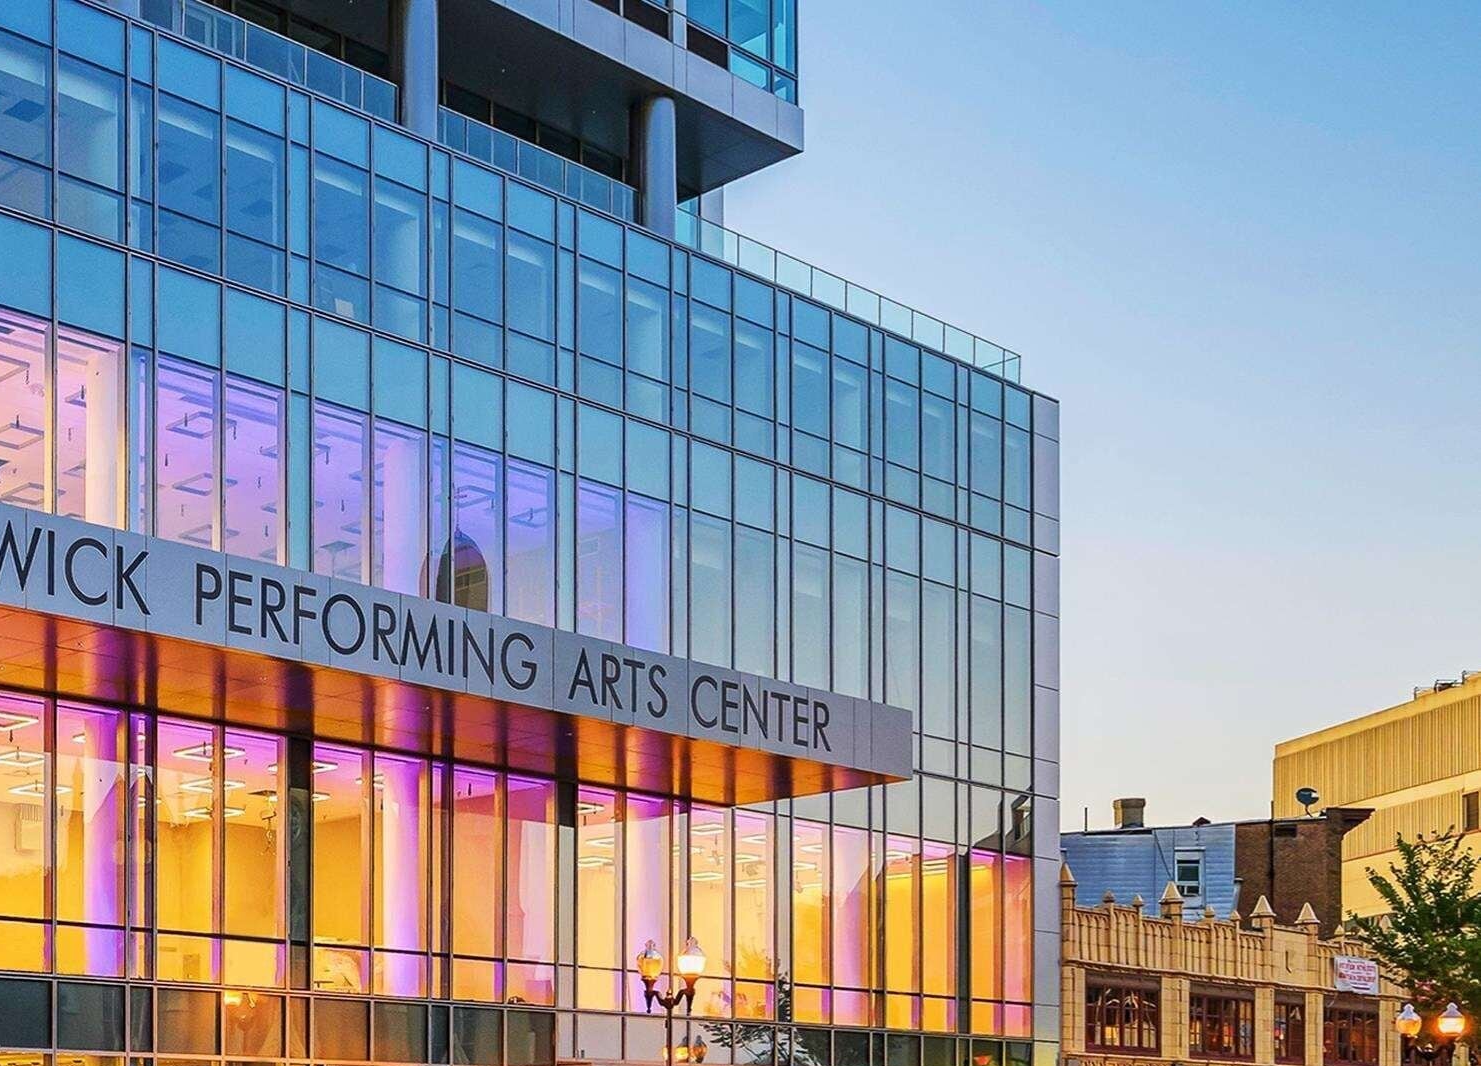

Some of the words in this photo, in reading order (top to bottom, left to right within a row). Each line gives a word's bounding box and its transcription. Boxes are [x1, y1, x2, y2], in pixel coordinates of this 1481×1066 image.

[195, 562, 538, 691] PERFORMING
[568, 647, 668, 718] ARTS
[691, 674, 832, 752] CENTER
